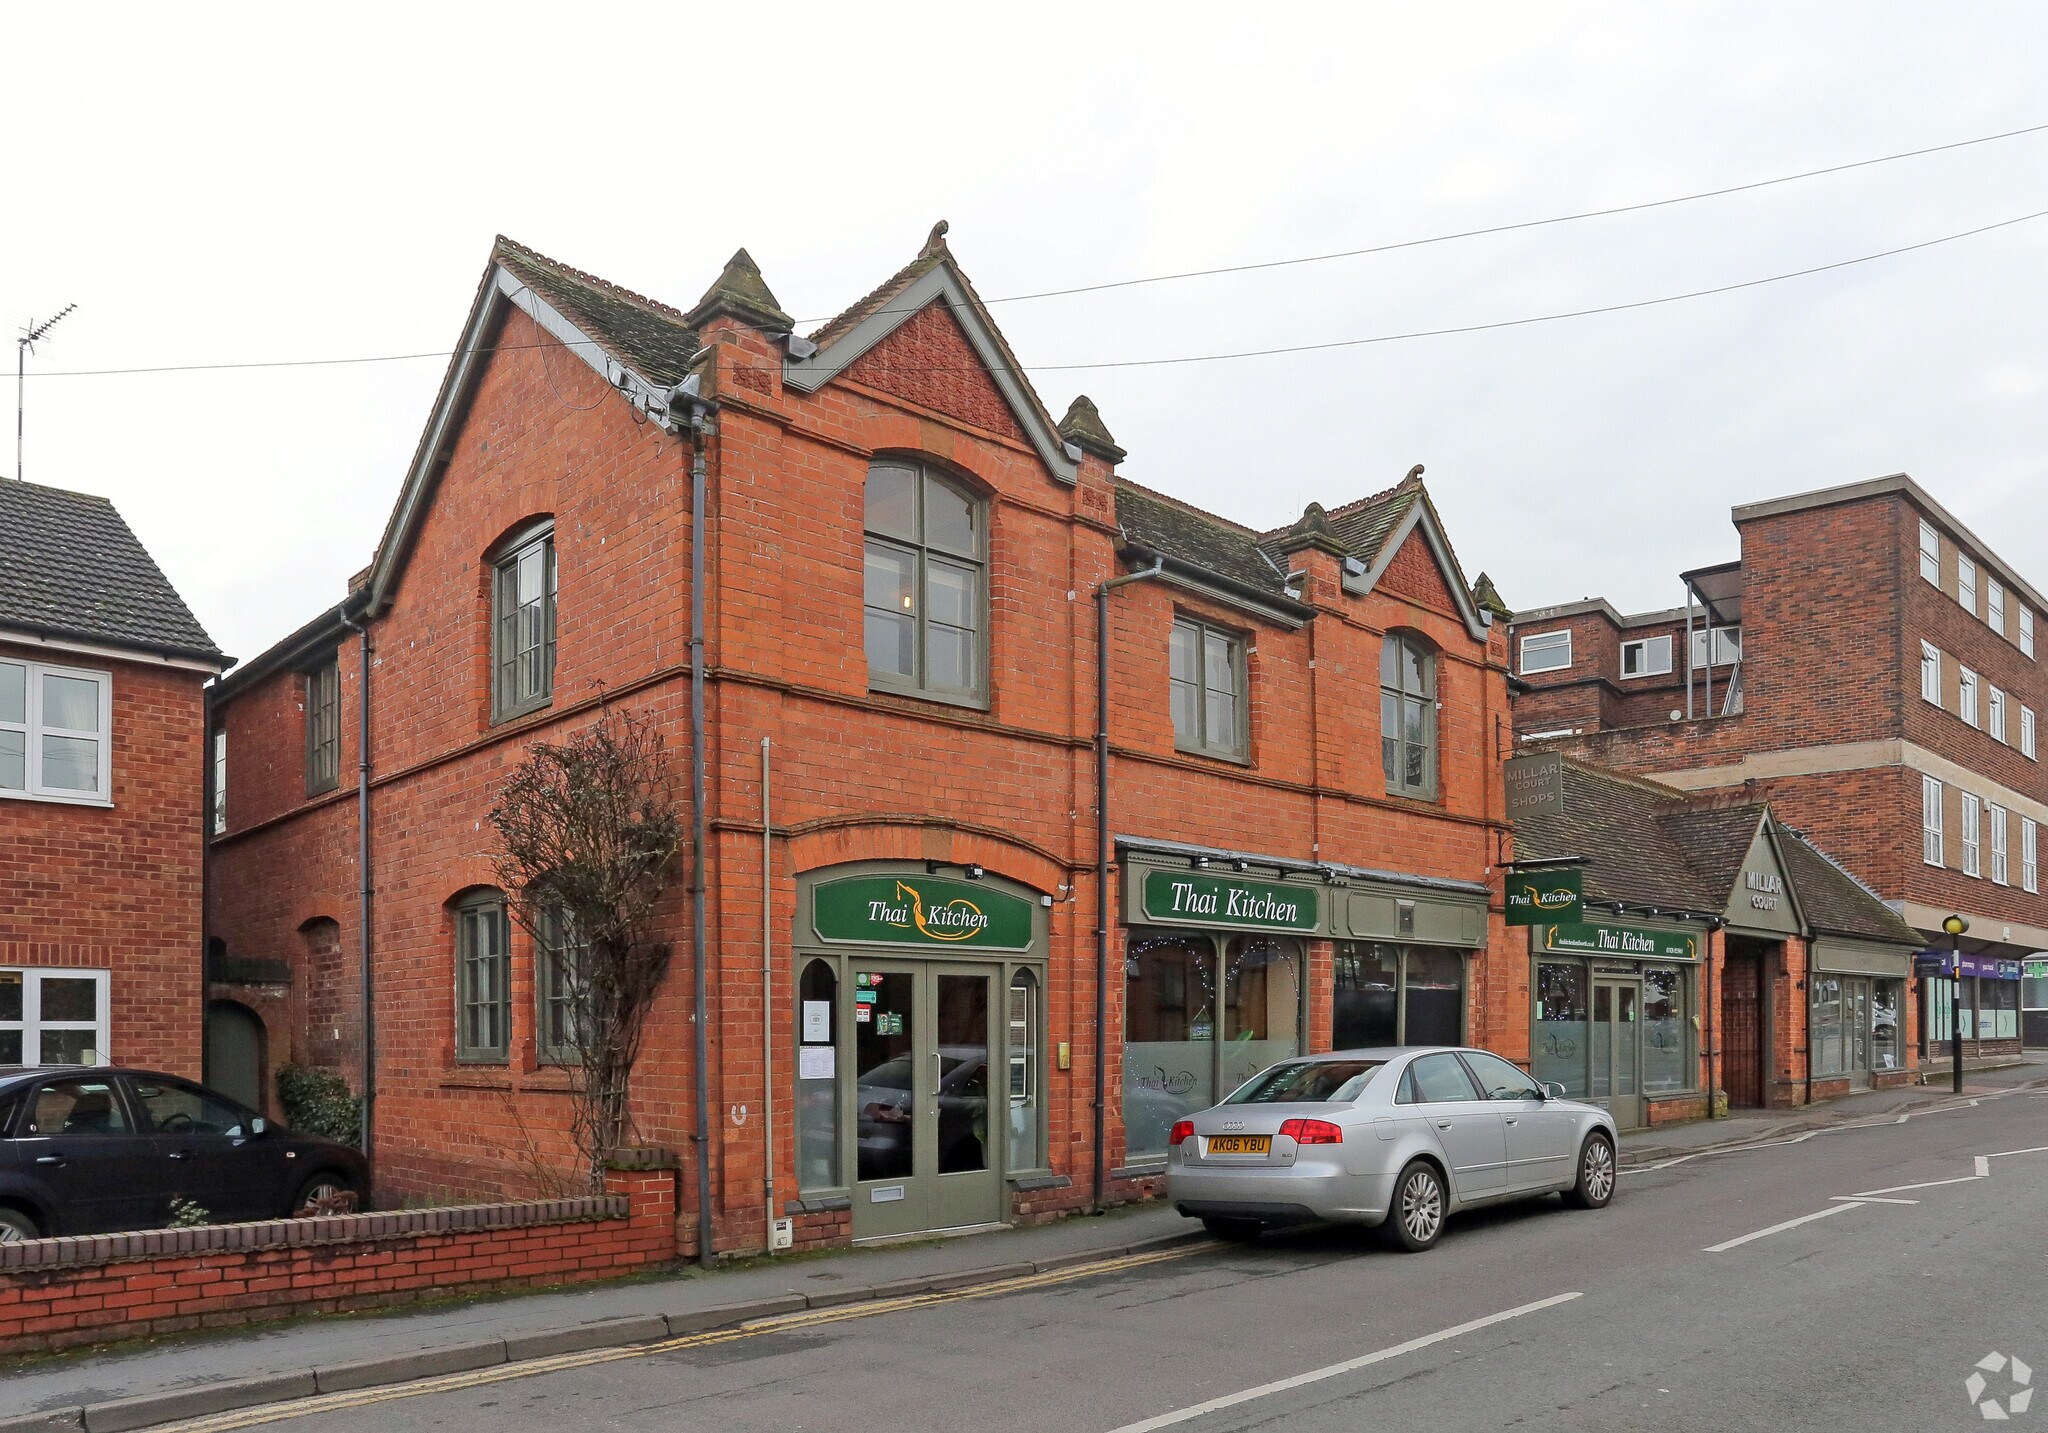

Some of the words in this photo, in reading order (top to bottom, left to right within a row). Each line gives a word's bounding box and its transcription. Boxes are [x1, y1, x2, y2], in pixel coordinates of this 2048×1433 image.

[1508, 763, 1559, 781] MILLAR
[1516, 777, 1552, 790] COURT
[1512, 792, 1555, 808] SHOPS
[1746, 871, 1782, 894] MILLAR
[1171, 882, 1219, 914] Thai
[1225, 888, 1298, 923] Kitchen
[1509, 894, 1530, 905] Thai
[1541, 892, 1577, 903] Kitchen
[1752, 894, 1778, 910] COURT
[868, 901, 908, 923] Thai
[927, 905, 989, 928] Kitchen
[1598, 928, 1620, 950] Thai
[1621, 932, 1655, 952] Kitchen
[1168, 1074, 1198, 1088] Kitchen
[1212, 1139, 1240, 1151] AK06
[1243, 1139, 1266, 1151] YBU
